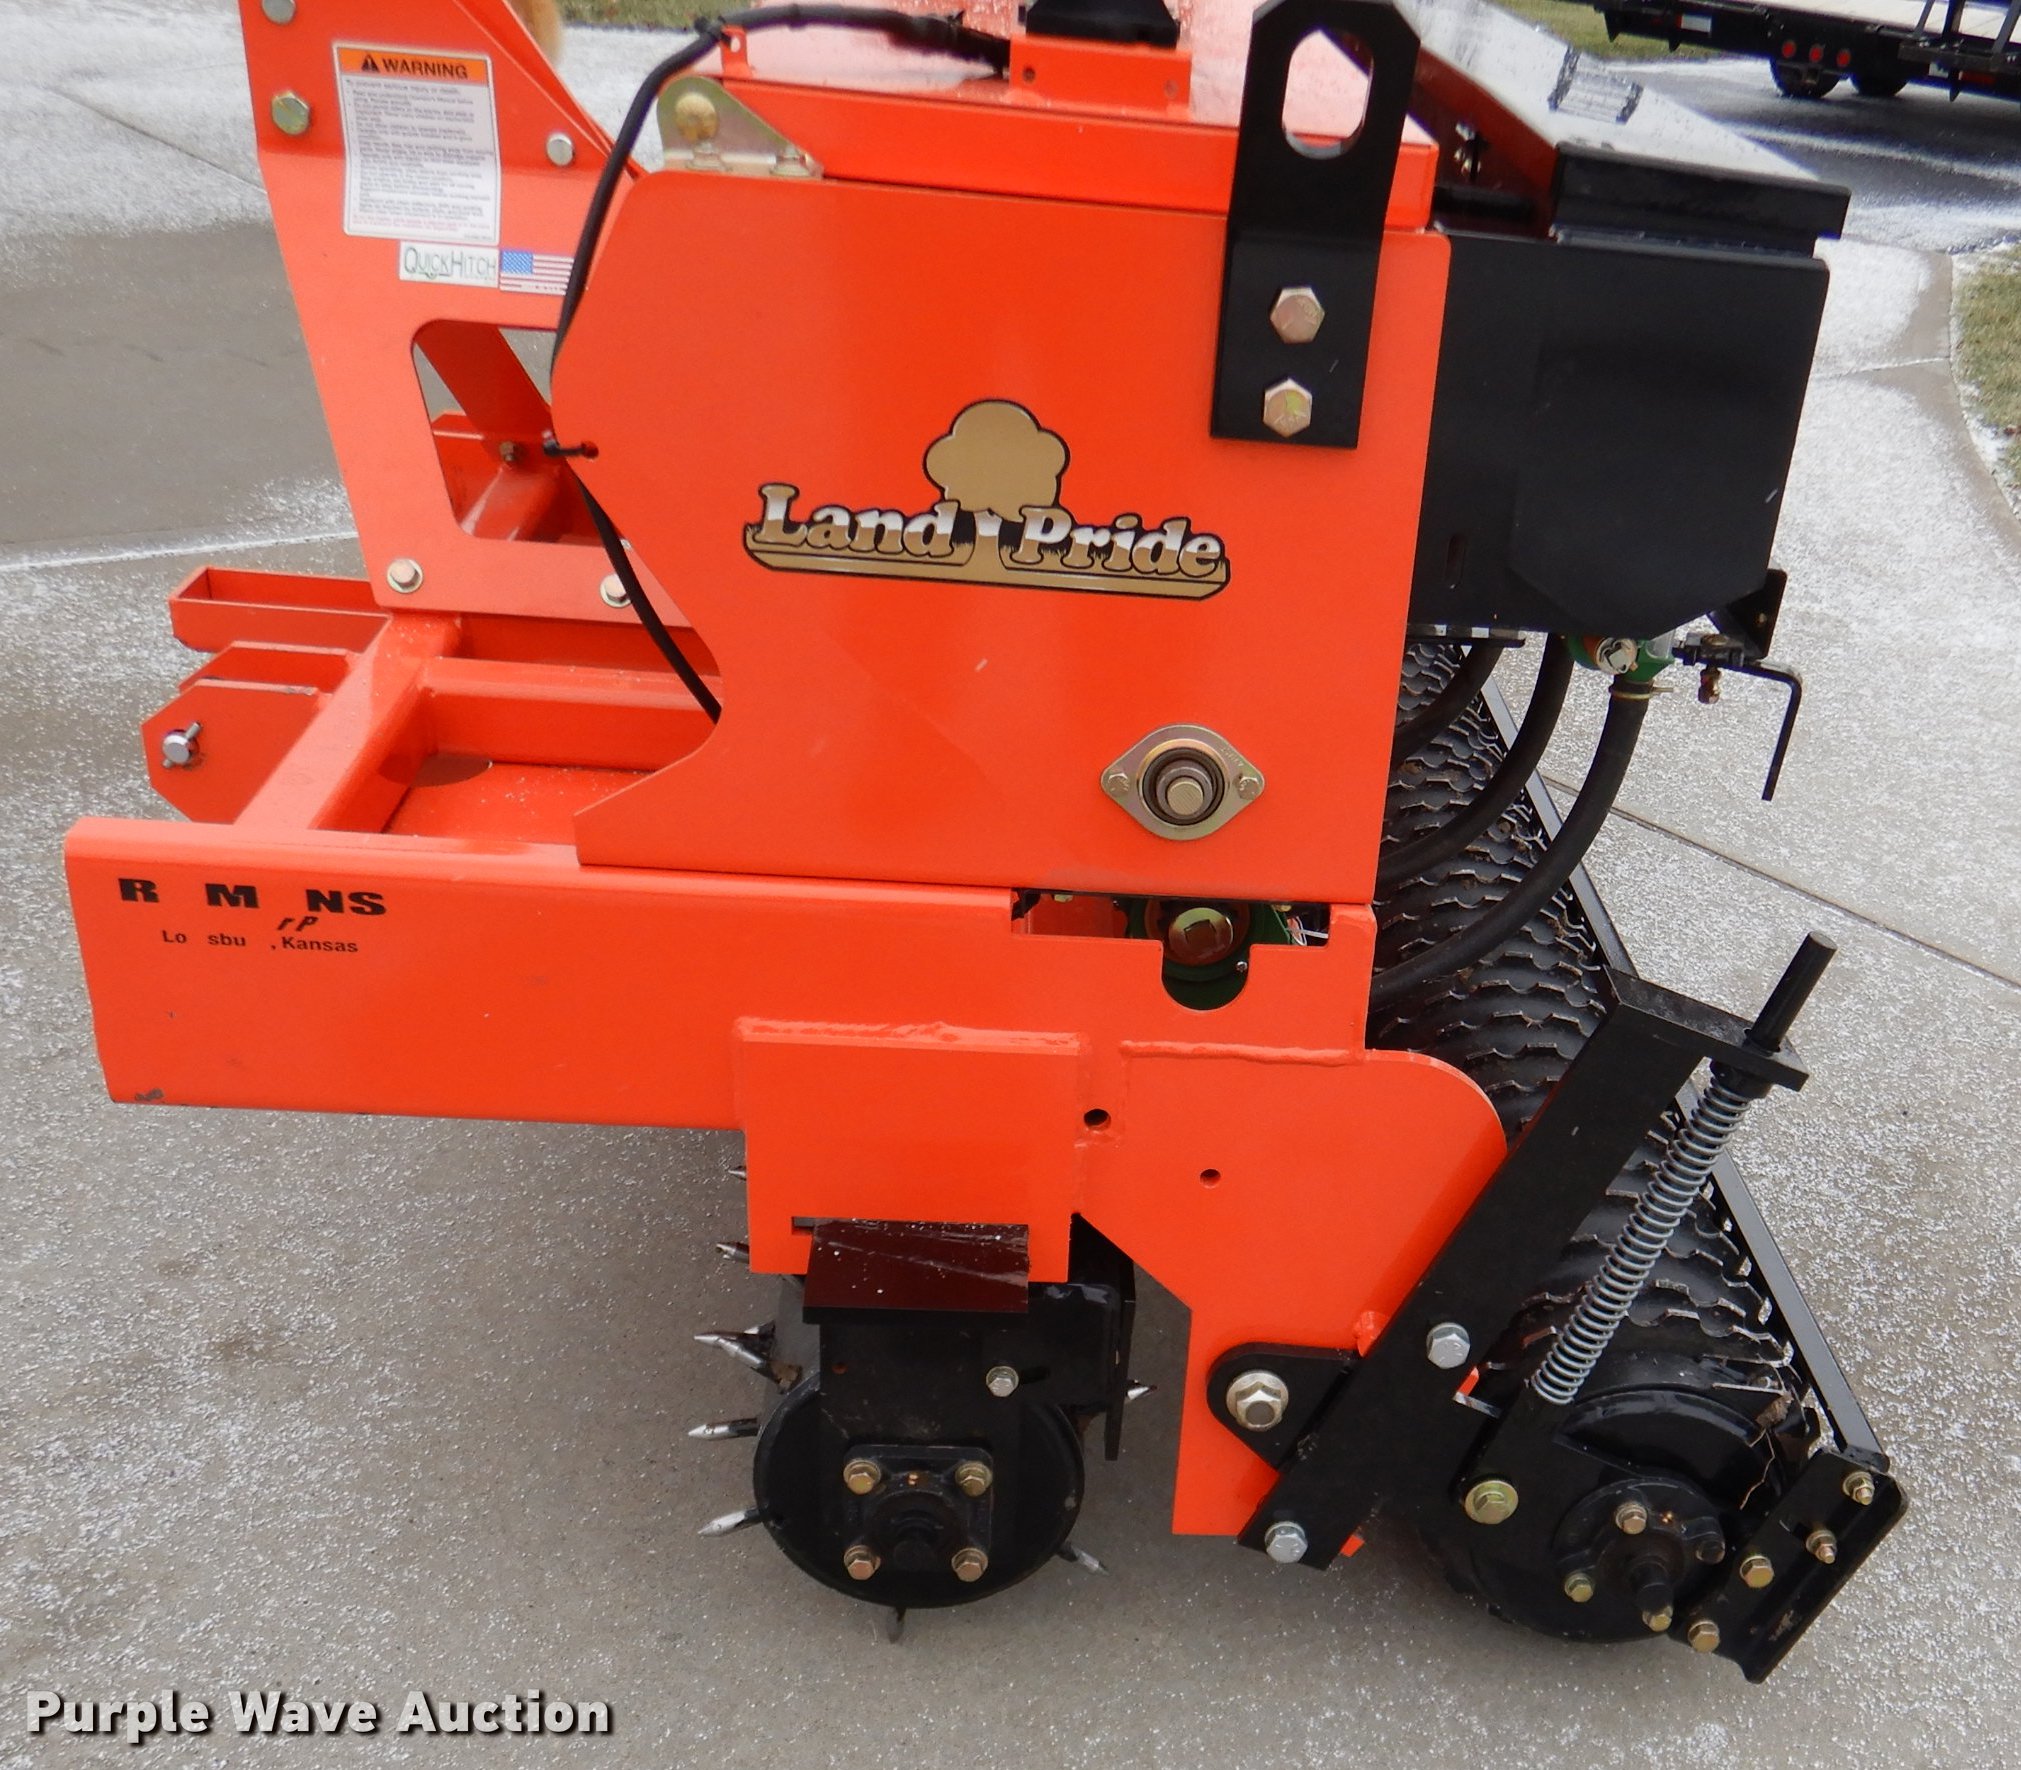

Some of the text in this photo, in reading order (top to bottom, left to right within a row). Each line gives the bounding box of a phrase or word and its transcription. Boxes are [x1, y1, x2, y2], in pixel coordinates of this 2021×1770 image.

[382, 57, 469, 80] WARNING
[754, 483, 1223, 577] Land Pride
